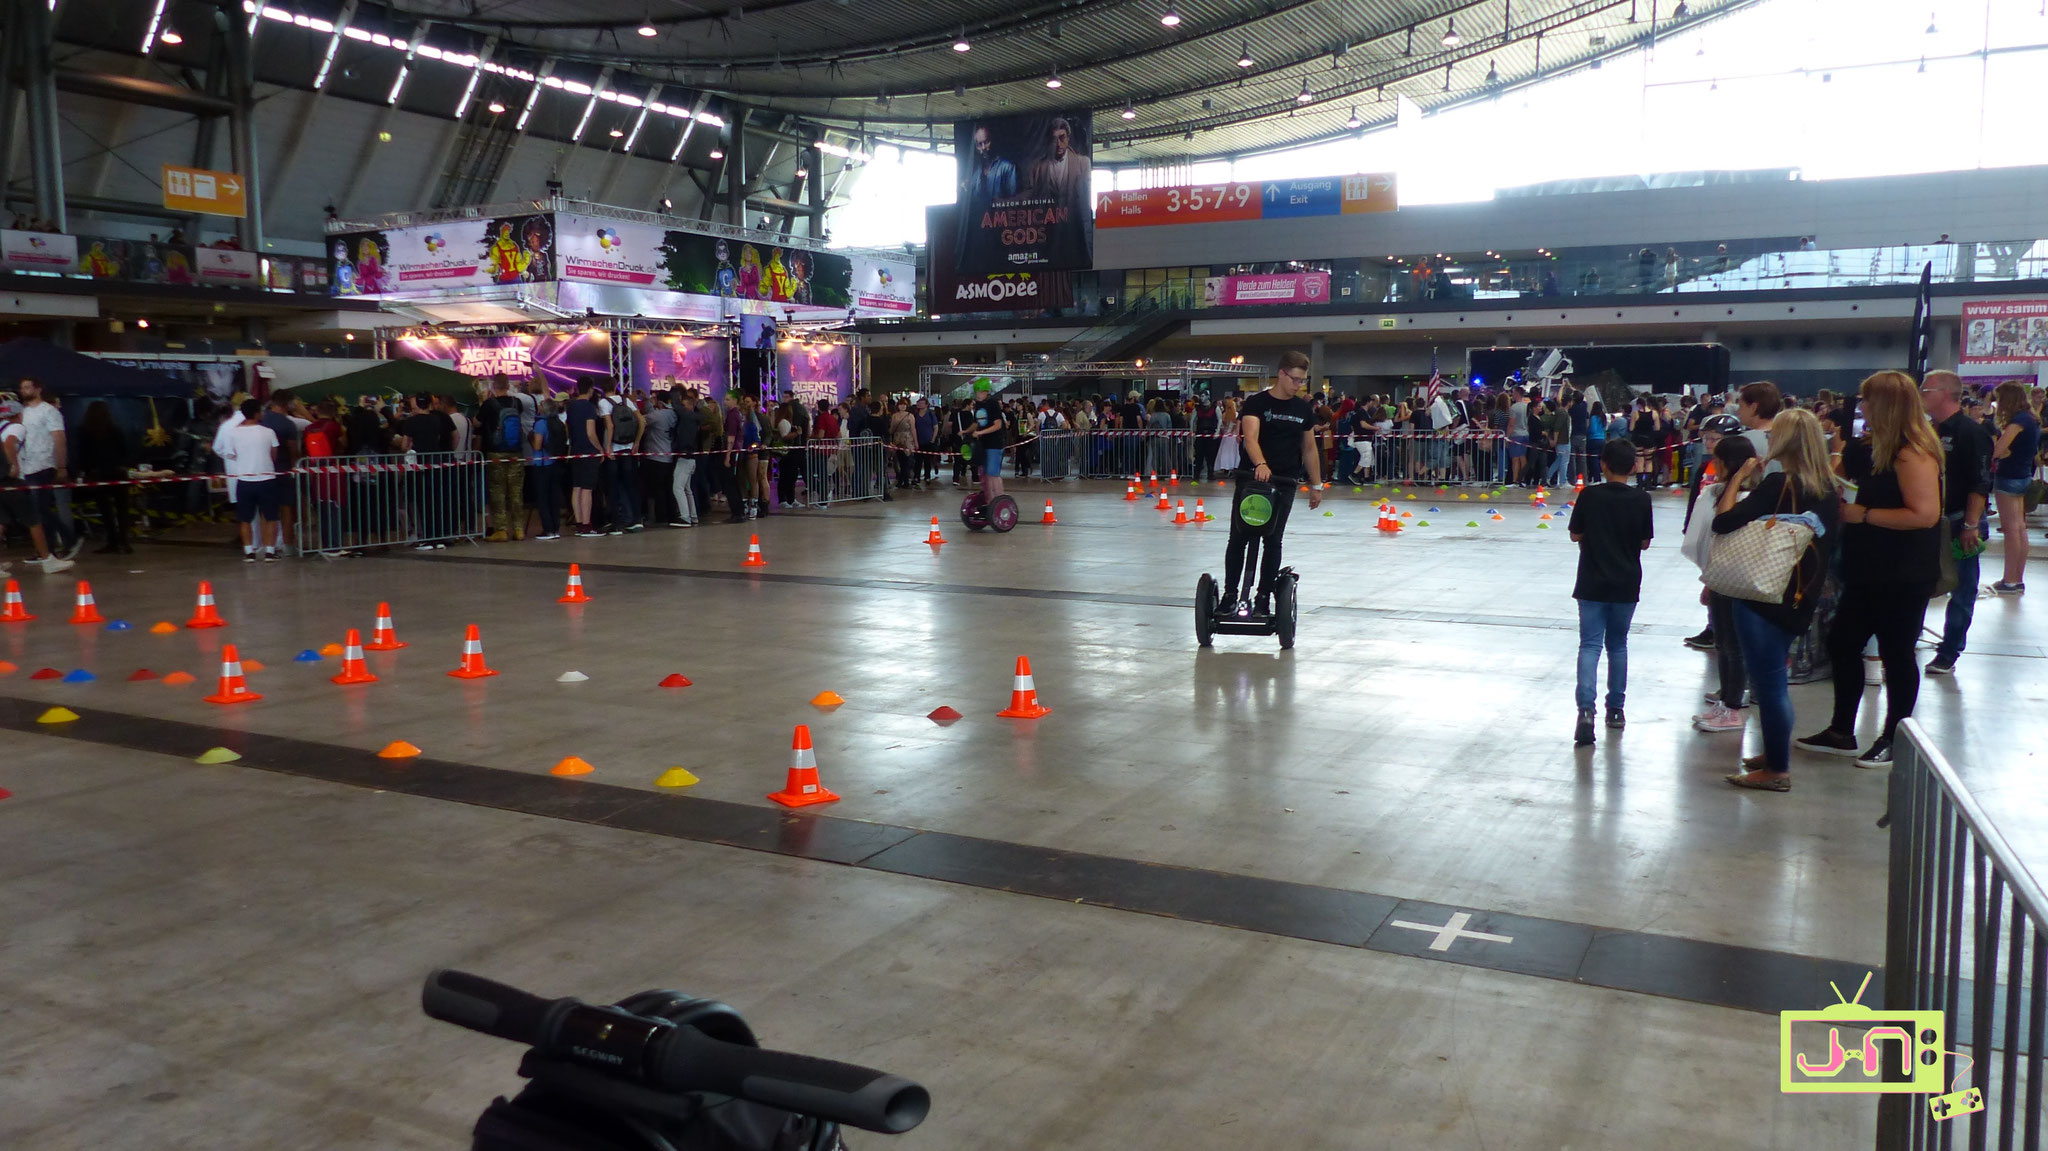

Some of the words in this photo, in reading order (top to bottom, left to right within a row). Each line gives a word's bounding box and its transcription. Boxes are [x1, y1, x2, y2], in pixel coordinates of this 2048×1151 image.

[1290, 180, 1332, 193] Ausgang
[992, 200, 1020, 208] AMAZON
[1022, 198, 1055, 206] ORIGINAL
[1121, 192, 1148, 202] Hallen
[1290, 194, 1308, 205] Exit
[1121, 205, 1142, 215] Halls
[981, 207, 1068, 229] AMERICAN
[1001, 227, 1047, 246] GODS
[567, 267, 577, 276] Sie
[599, 271, 607, 279] wir
[1237, 281, 1256, 290] Werde
[1257, 281, 1271, 290] zum
[1272, 279, 1297, 289] Helden!
[461, 347, 531, 363] AGENTS
[460, 361, 532, 376] MAYHEM
[791, 381, 838, 395] AGENTS
[573, 1045, 623, 1064] SEGWAY
